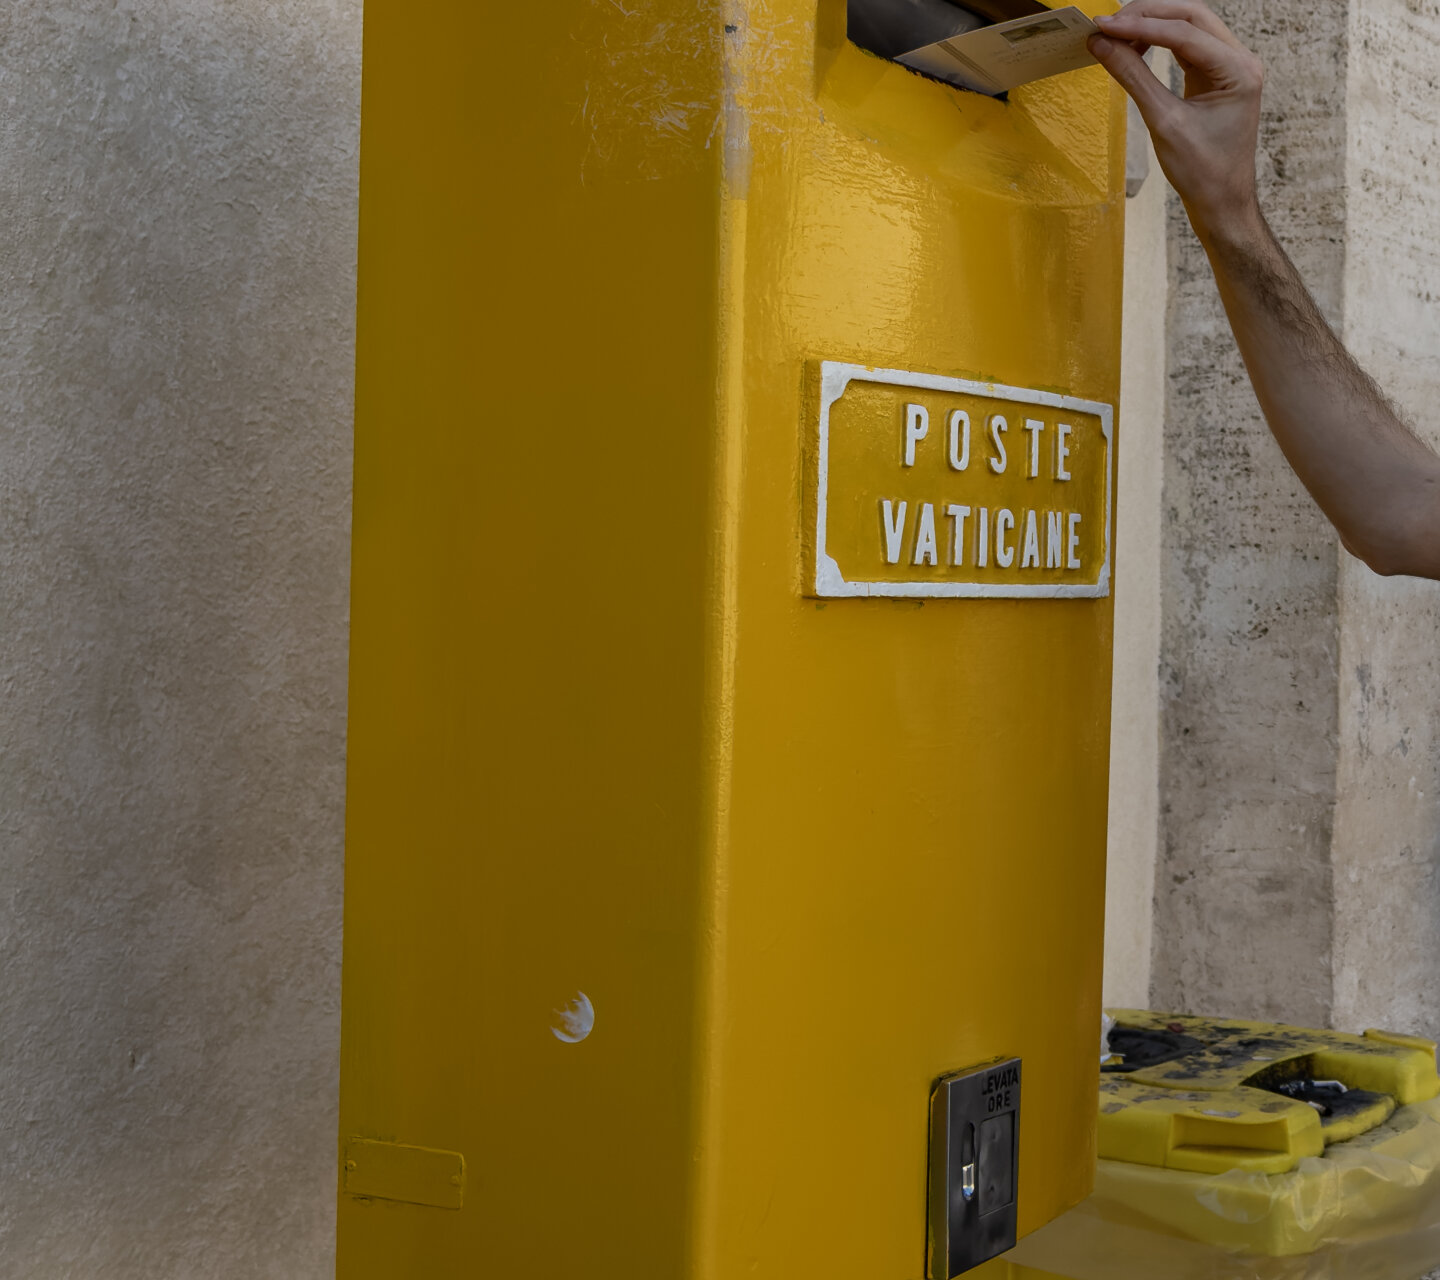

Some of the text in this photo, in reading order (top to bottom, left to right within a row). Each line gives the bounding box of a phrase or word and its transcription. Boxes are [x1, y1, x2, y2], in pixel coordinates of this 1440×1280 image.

[903, 402, 1072, 481] POSTE
[881, 500, 1082, 569] VATICANE
[988, 1090, 1010, 1112] ORE
